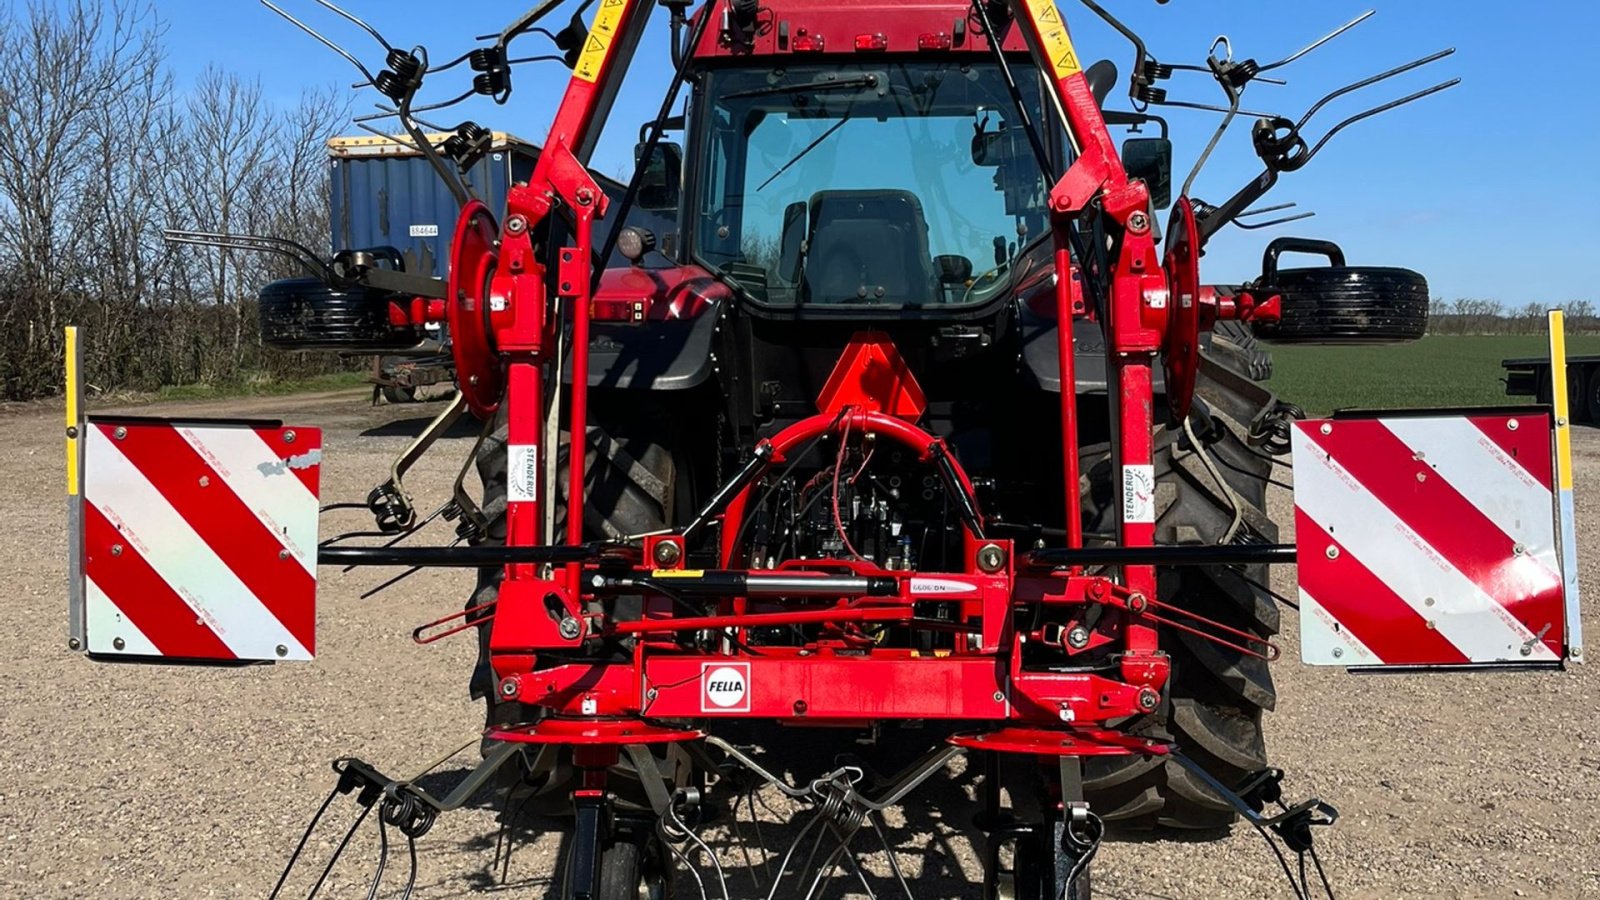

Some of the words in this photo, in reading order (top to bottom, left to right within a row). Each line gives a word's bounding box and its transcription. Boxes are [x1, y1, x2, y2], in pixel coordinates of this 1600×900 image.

[526, 448, 535, 498] STENDERUP
[1125, 468, 1135, 520] STENDERUP
[709, 681, 743, 692] FELLA
